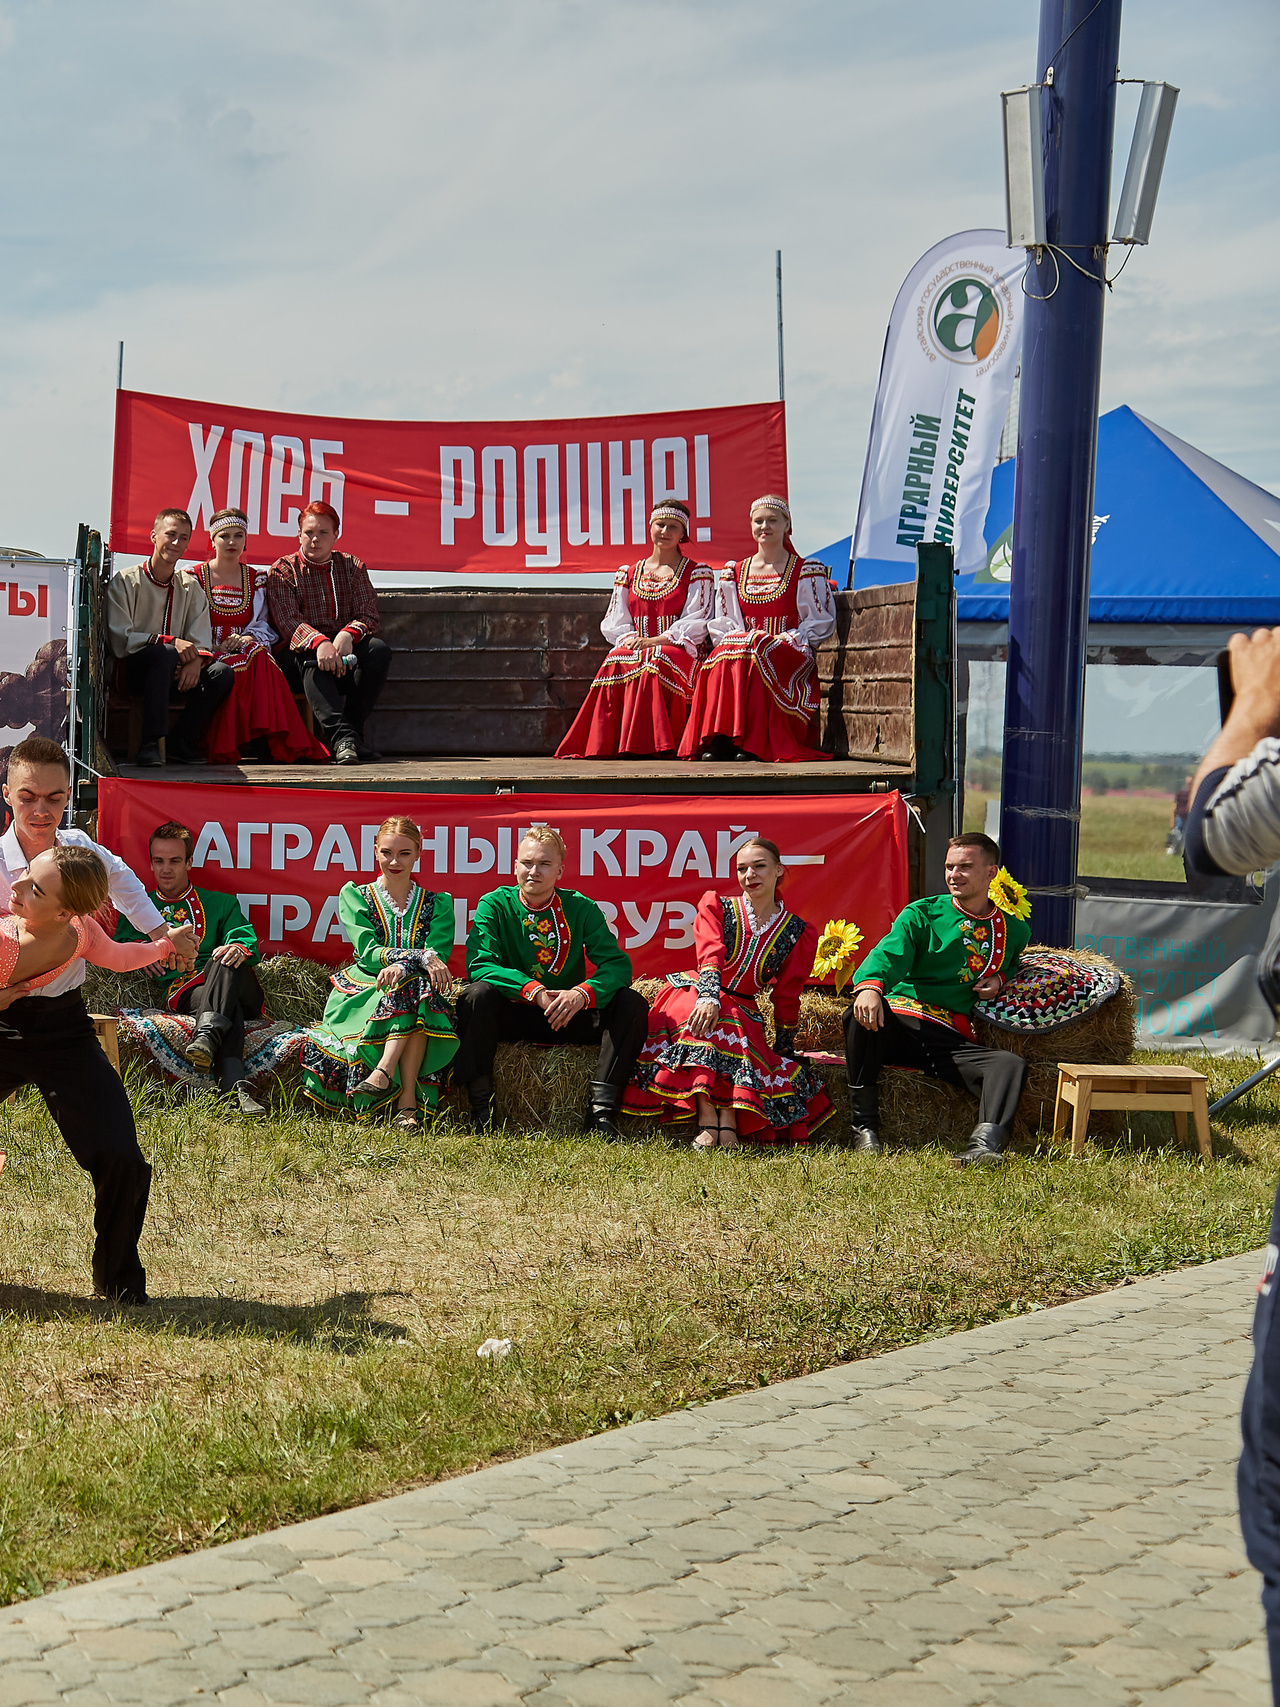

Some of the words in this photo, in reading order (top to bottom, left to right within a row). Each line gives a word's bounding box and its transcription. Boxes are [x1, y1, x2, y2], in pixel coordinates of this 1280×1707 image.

[896, 413, 942, 548] АГРАРНЫЙ
[933, 388, 977, 546] НИВЕРСИТЕТ
[191, 821, 560, 875] АГРАНЫ
